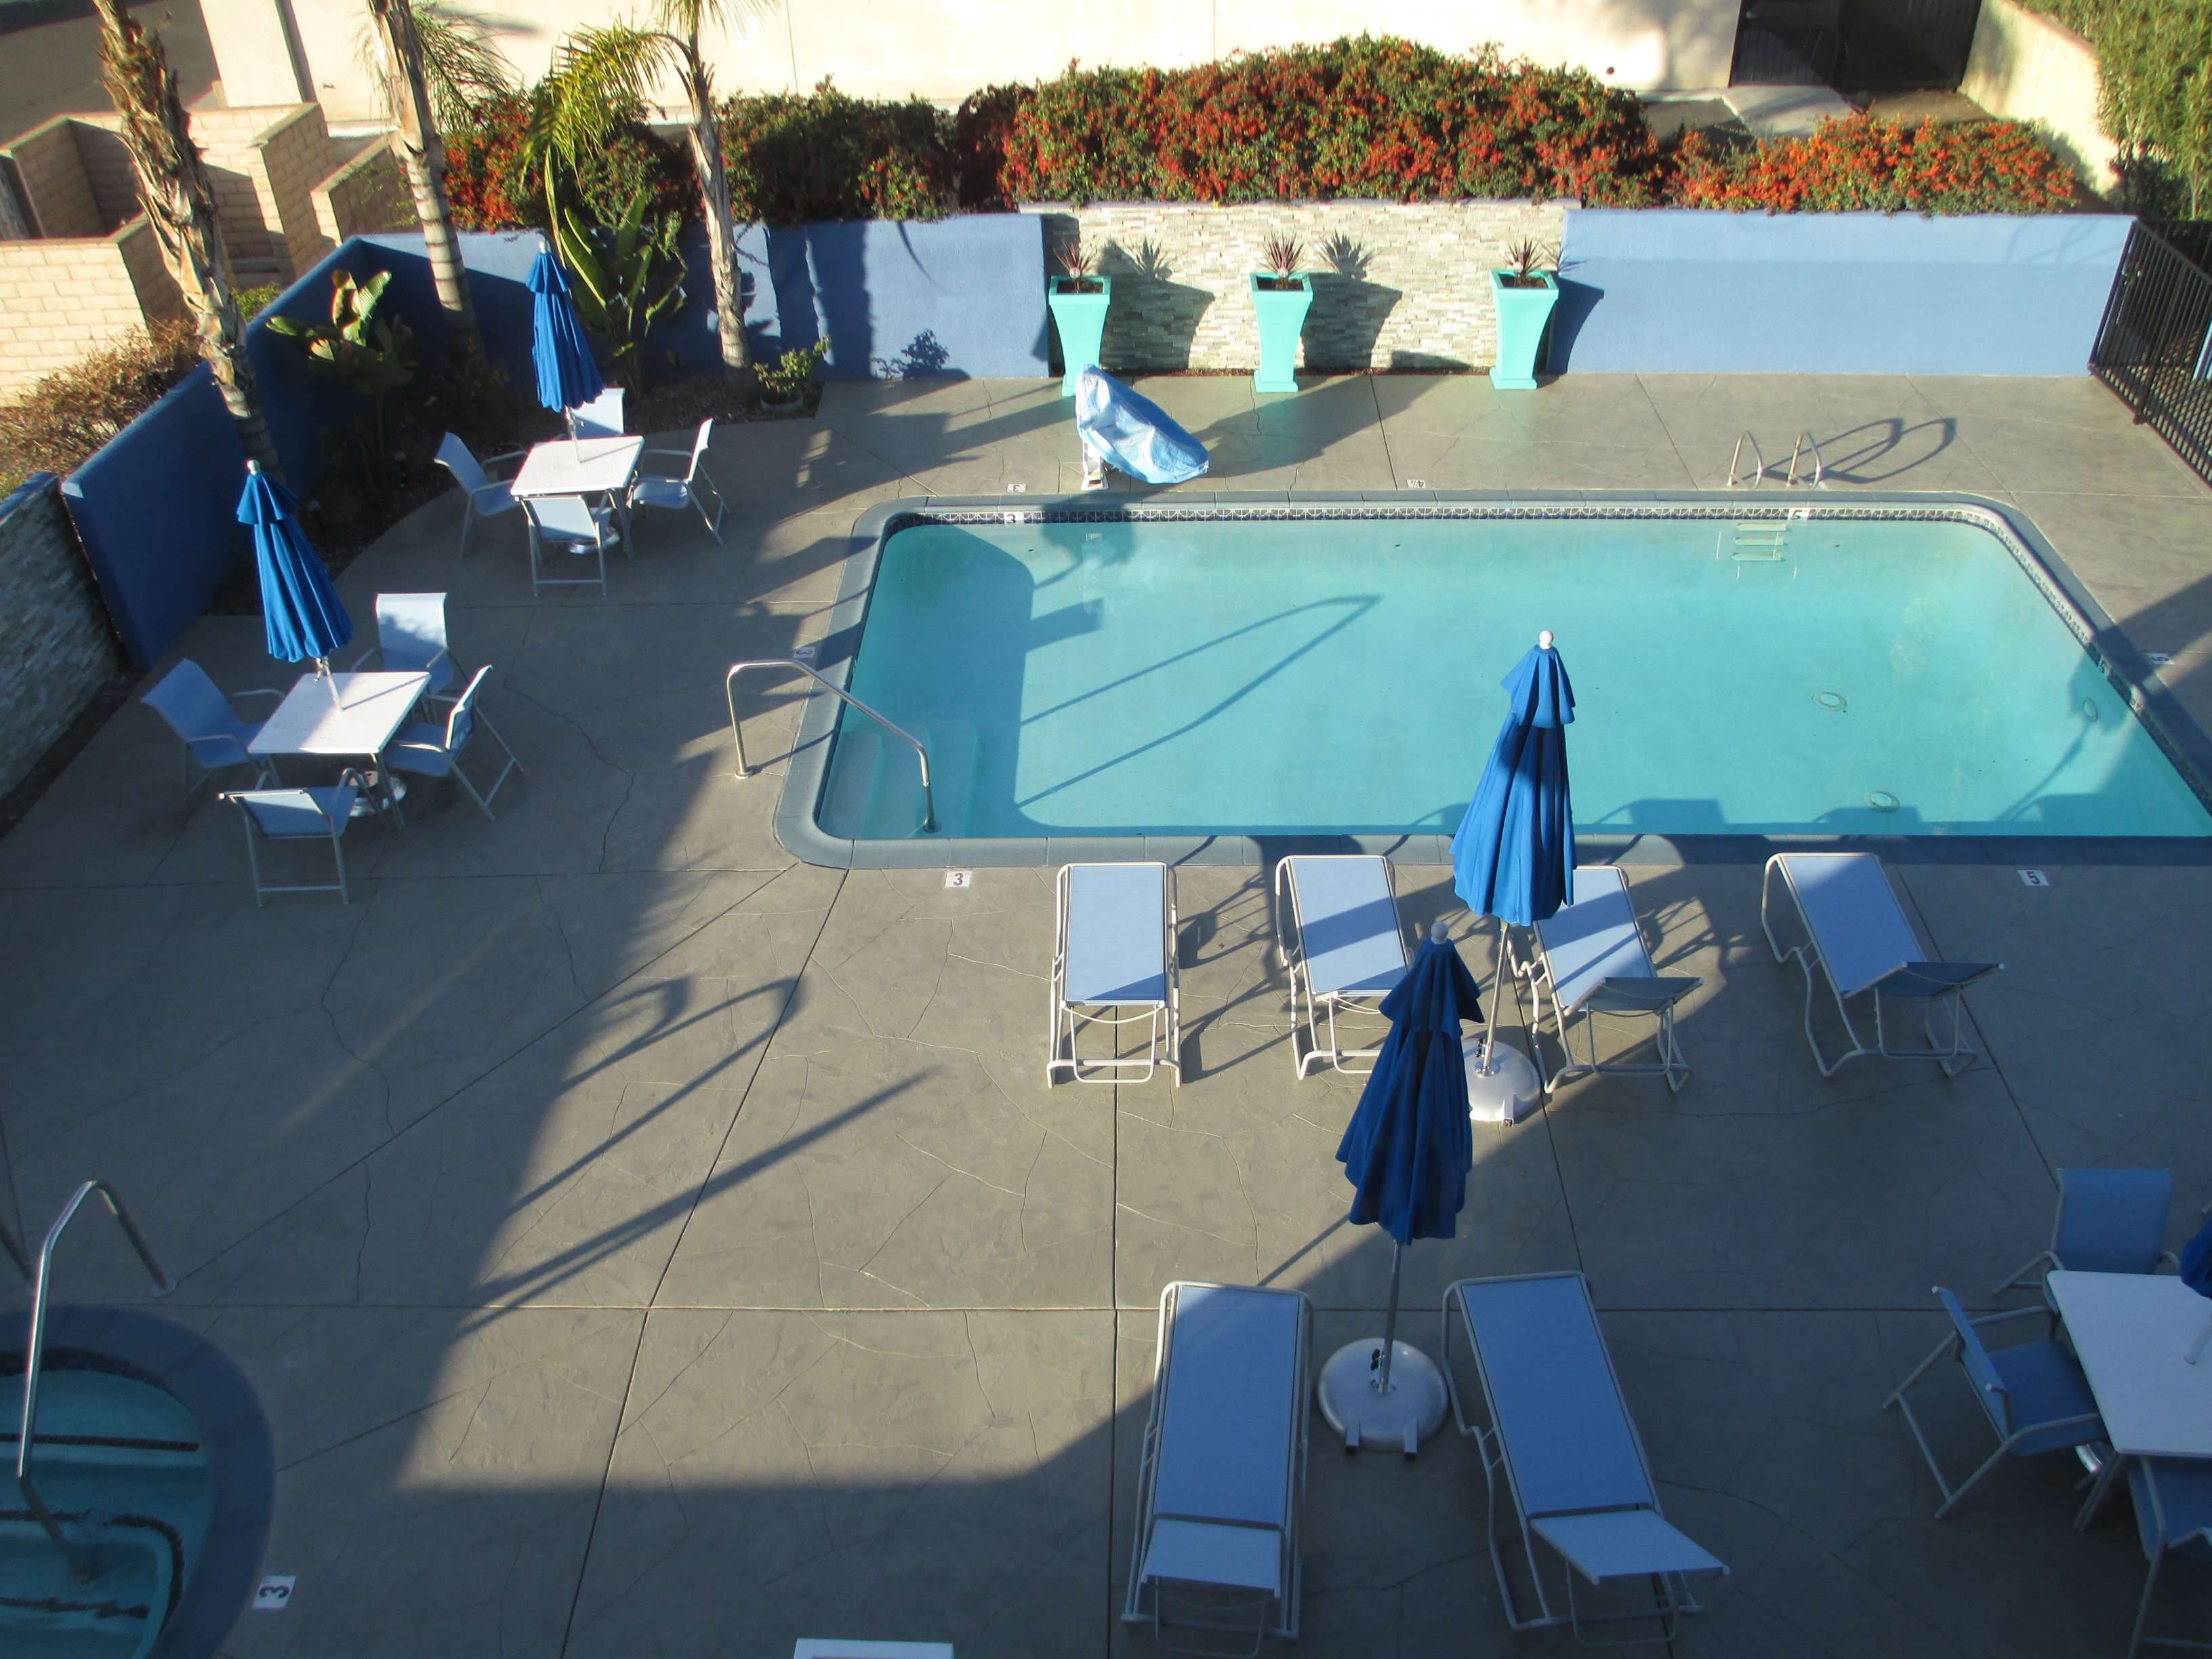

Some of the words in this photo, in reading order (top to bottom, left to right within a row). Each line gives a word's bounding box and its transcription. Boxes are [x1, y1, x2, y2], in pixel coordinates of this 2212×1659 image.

[1790, 510, 1802, 520] 5
[954, 872, 964, 886] 3
[2026, 871, 2040, 884] 5
[259, 1585, 289, 1598] 3
